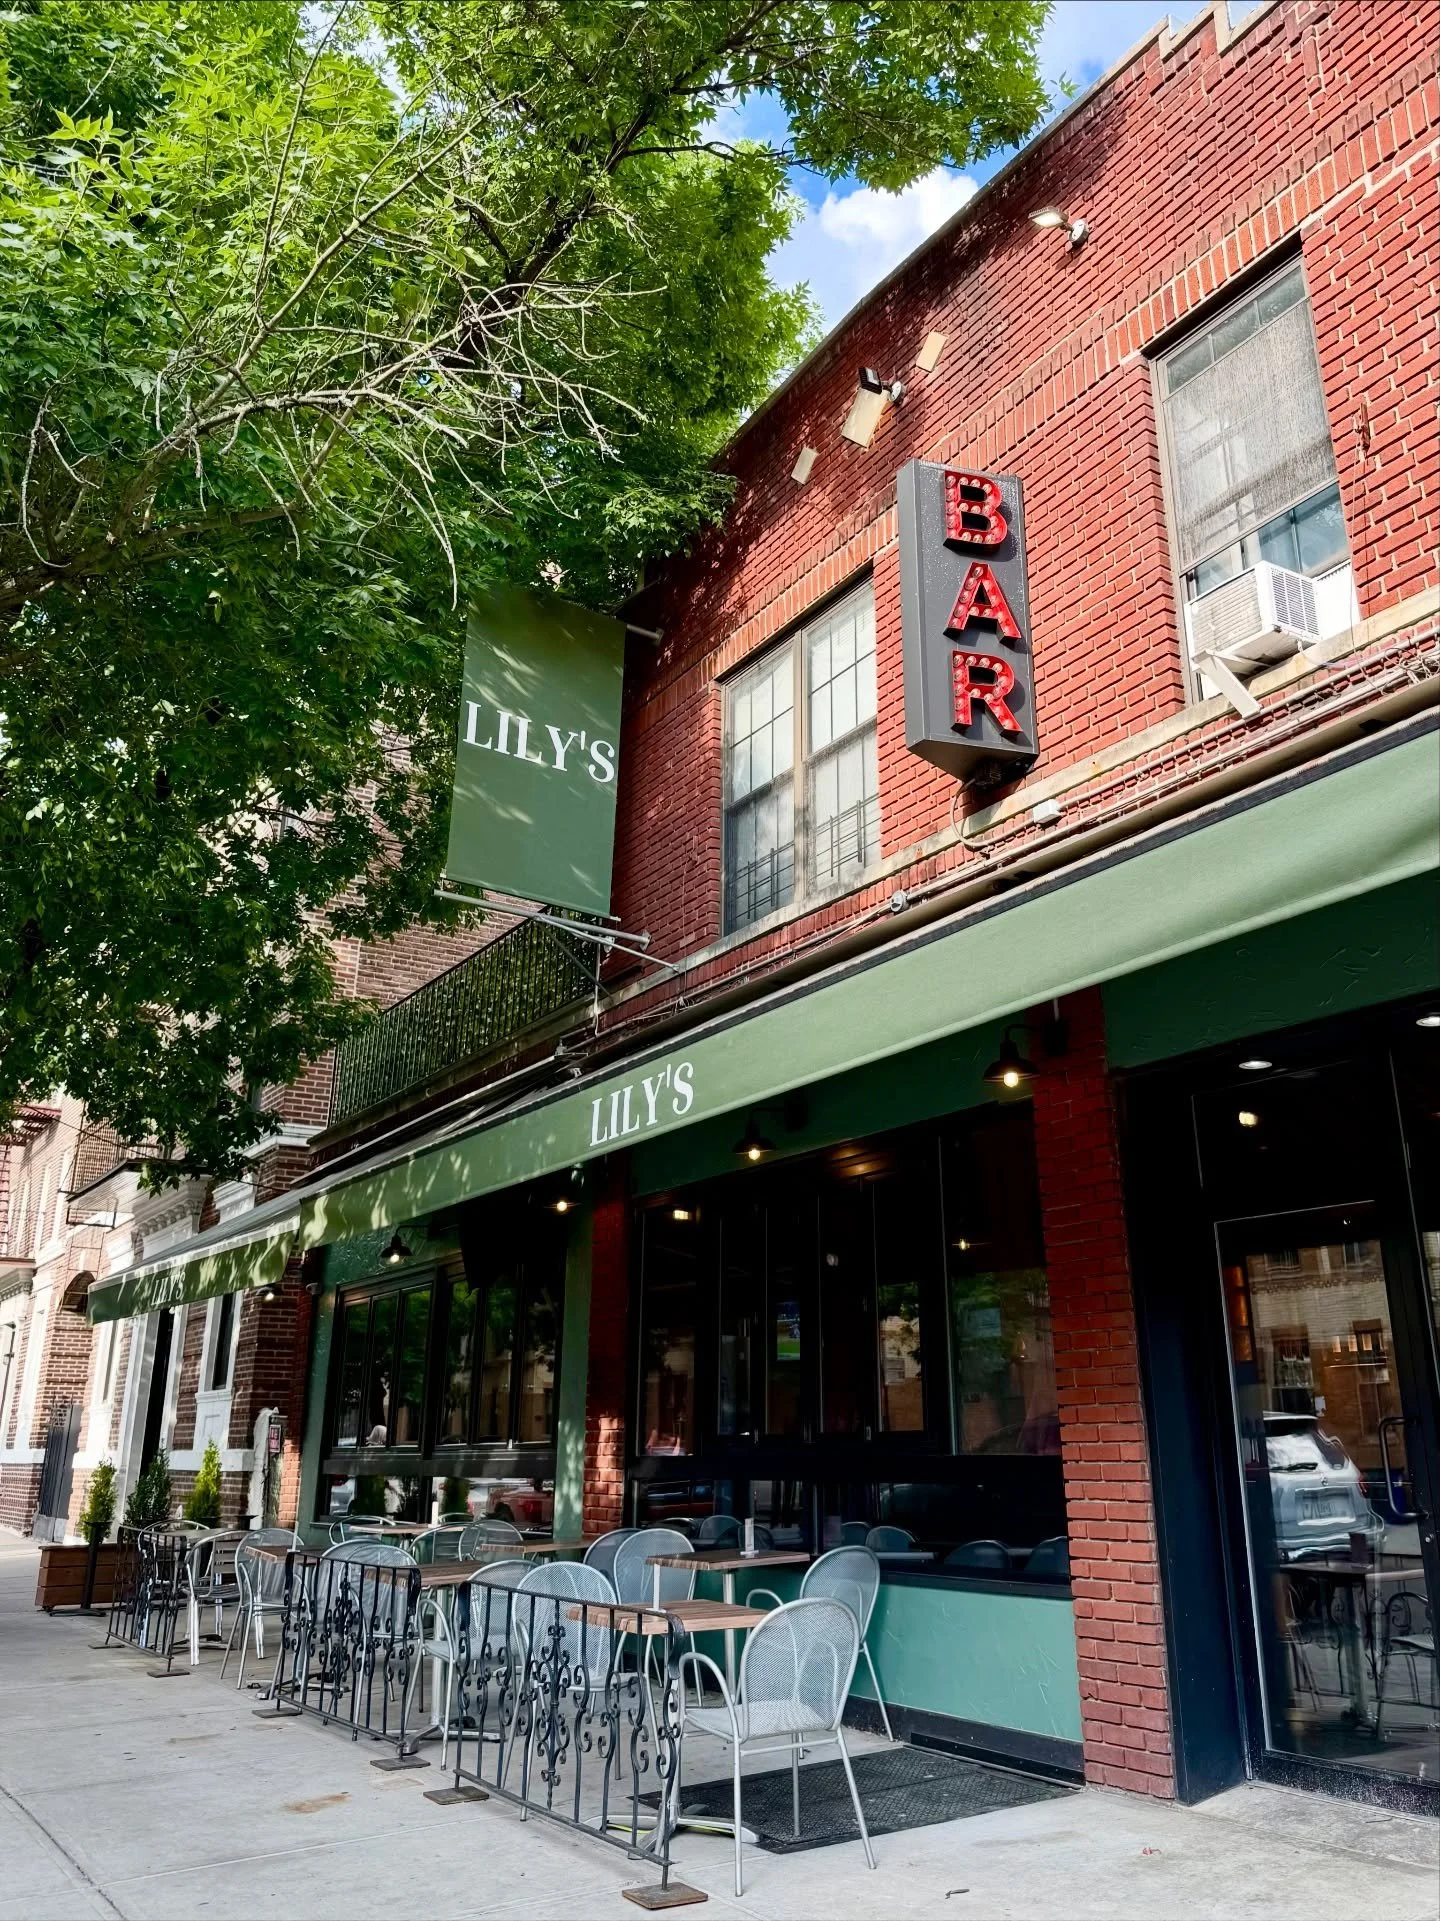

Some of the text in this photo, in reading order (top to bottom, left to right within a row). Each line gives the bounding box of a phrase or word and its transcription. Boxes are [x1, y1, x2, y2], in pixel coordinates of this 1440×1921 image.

[943, 470, 1023, 736] BAR
[462, 700, 615, 783] LILY'S
[589, 1061, 694, 1147] LILY'S
[150, 1271, 186, 1306] LILY'S
